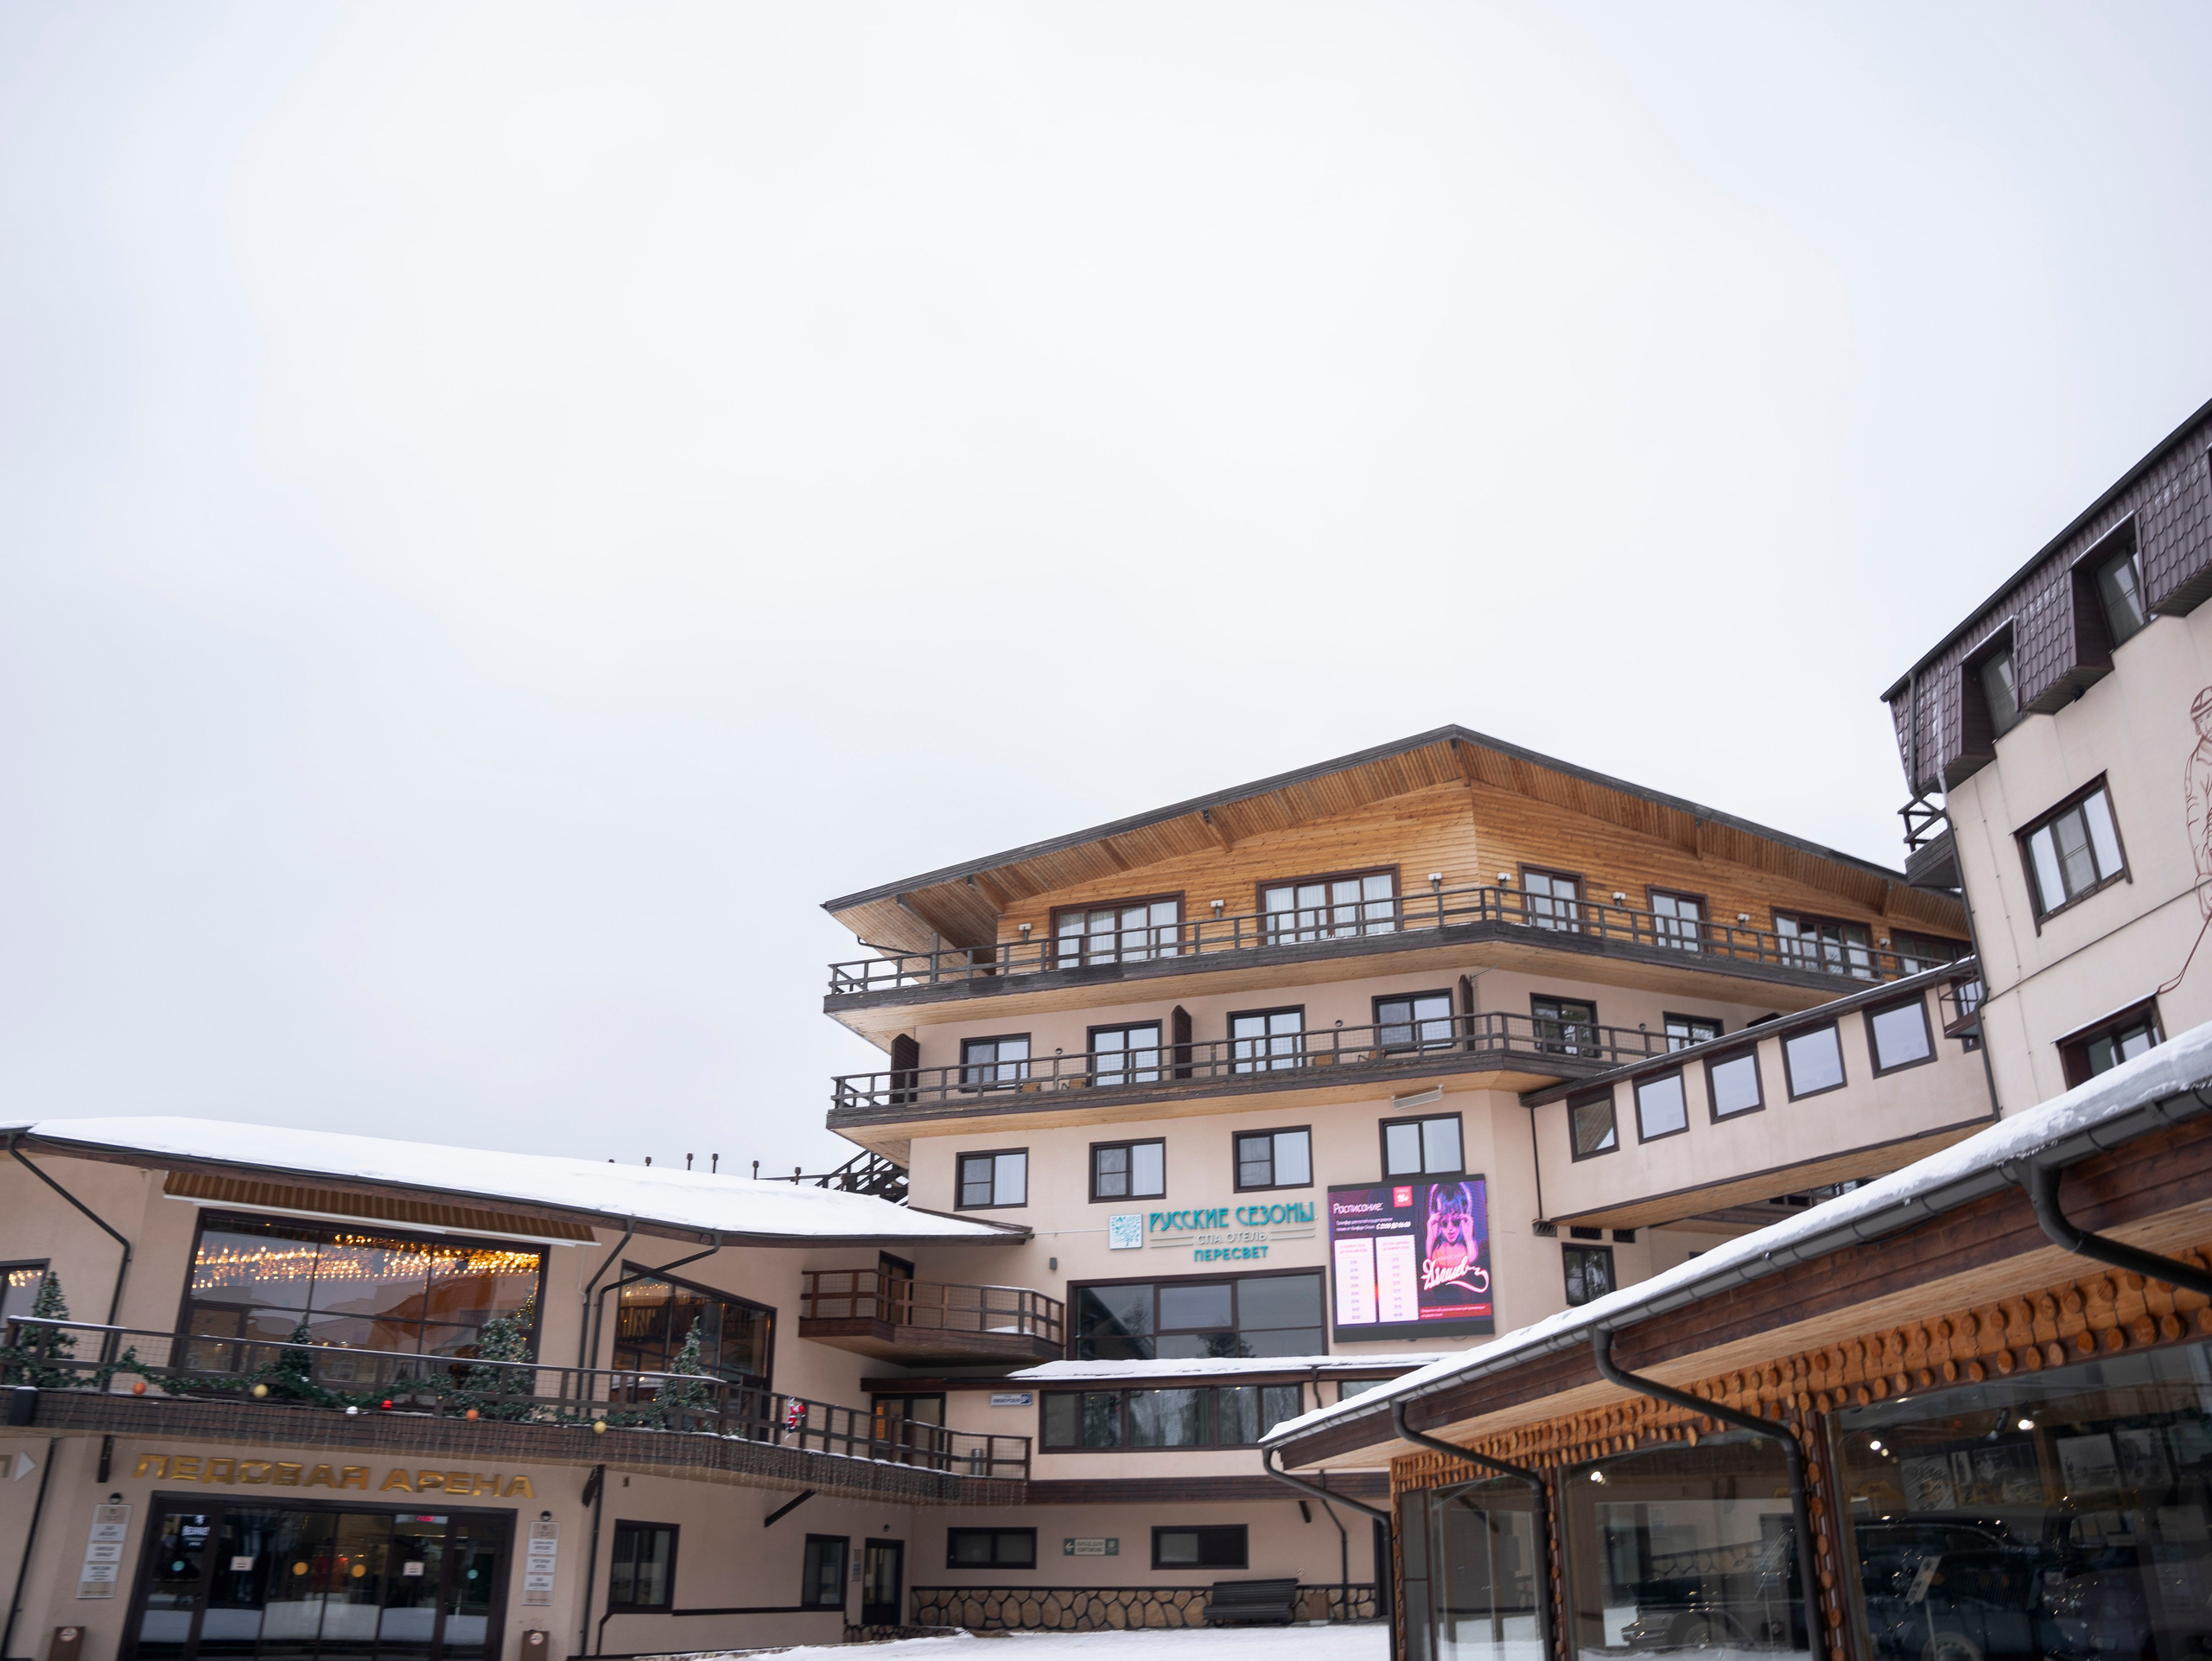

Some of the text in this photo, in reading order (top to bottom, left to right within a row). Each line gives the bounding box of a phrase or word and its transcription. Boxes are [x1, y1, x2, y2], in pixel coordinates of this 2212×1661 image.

[1149, 1201, 1314, 1232] РУССКИЕ СЕЗОНЫ
[1196, 1231, 1268, 1245] СПА ОТЕЛЬ
[1193, 1245, 1268, 1262] ПЕРЕСВЕТ
[133, 1454, 536, 1500] ЛЕДОВАЯ АРЕНА
